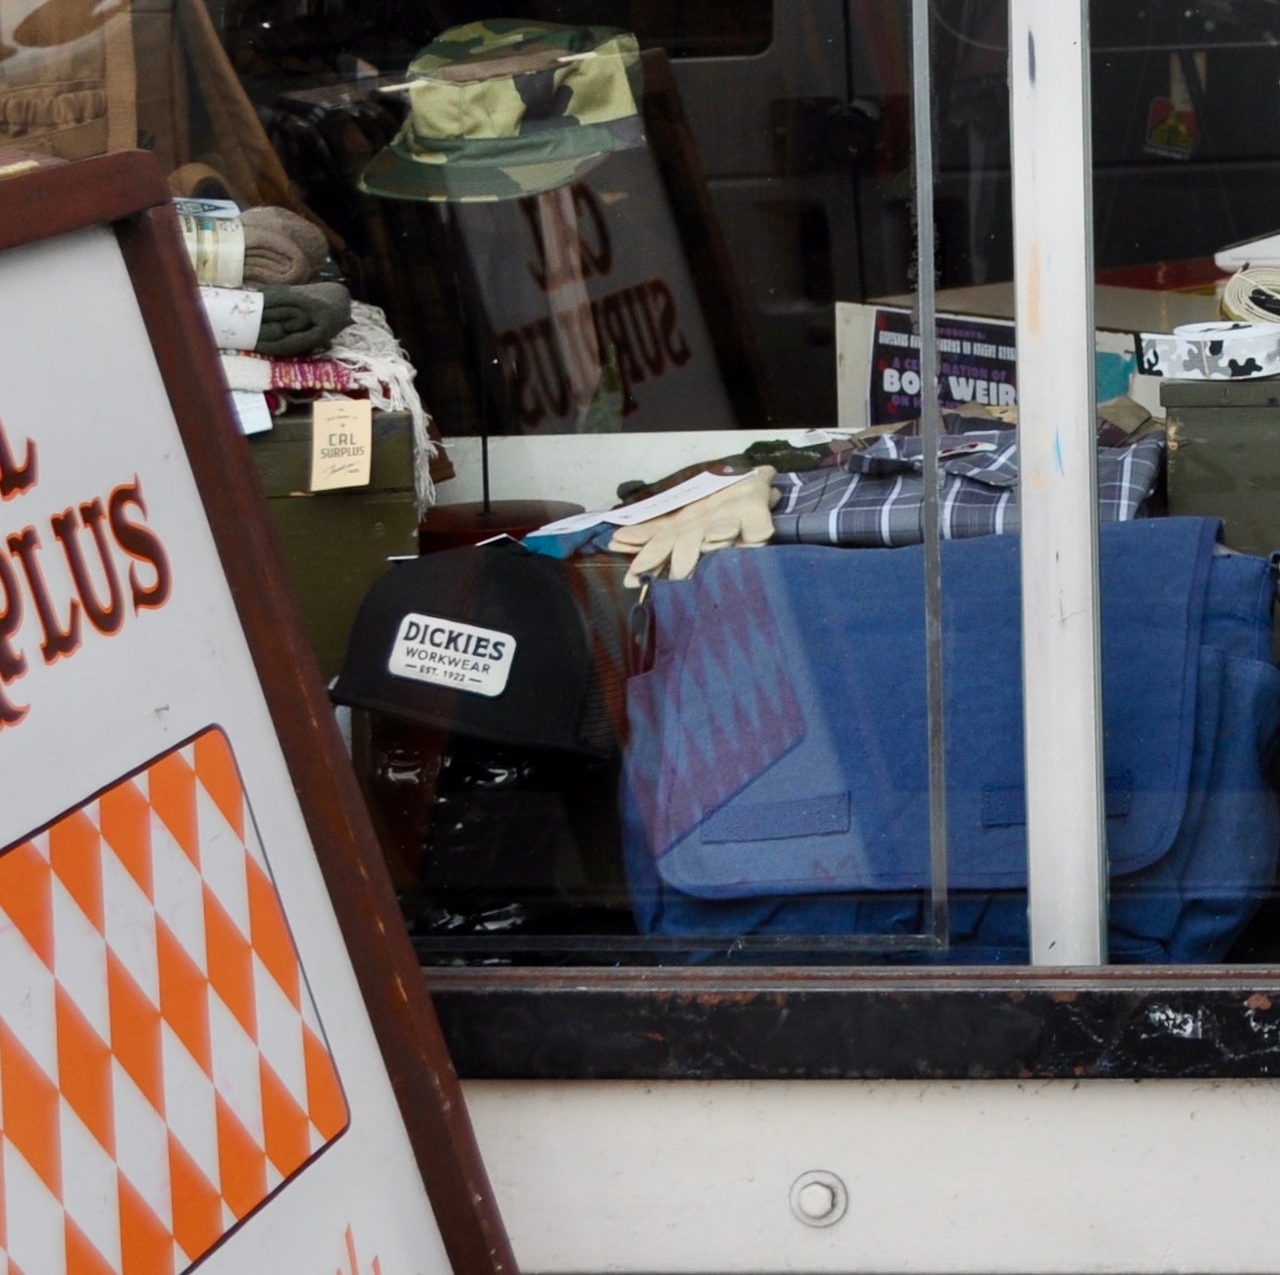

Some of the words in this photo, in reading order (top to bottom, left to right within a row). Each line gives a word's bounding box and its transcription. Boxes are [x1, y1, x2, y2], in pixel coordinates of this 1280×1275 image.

[883, 368, 938, 395] BO
[328, 433, 357, 446] CAL
[320, 445, 366, 460] SURPLUS
[403, 620, 506, 662] DICKIES
[406, 646, 491, 675] WORKWEAR
[419, 664, 439, 676] EST.
[443, 670, 467, 683] 1922
